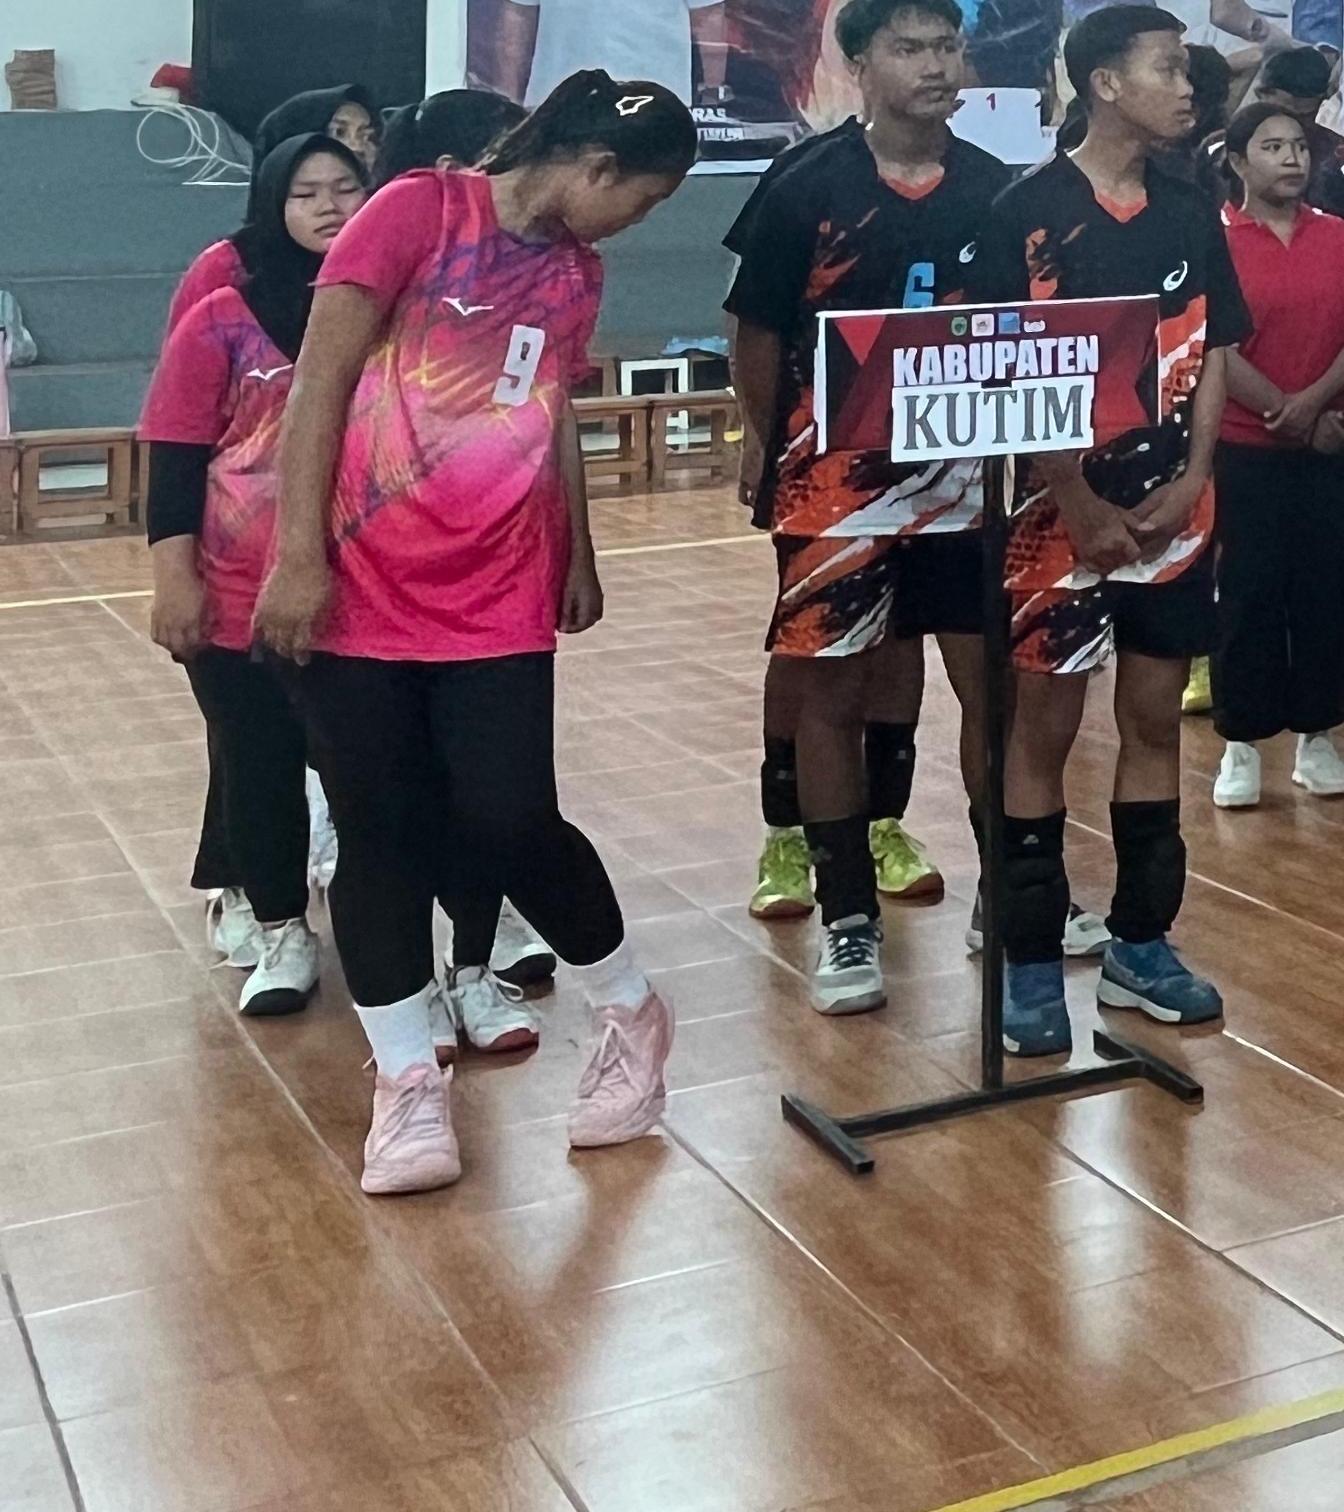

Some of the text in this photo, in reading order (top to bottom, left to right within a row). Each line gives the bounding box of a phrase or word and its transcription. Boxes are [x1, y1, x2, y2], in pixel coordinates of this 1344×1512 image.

[493, 325, 546, 406] 9
[893, 335, 1099, 387] KABUPATEN
[902, 384, 1085, 451] KUTIM
